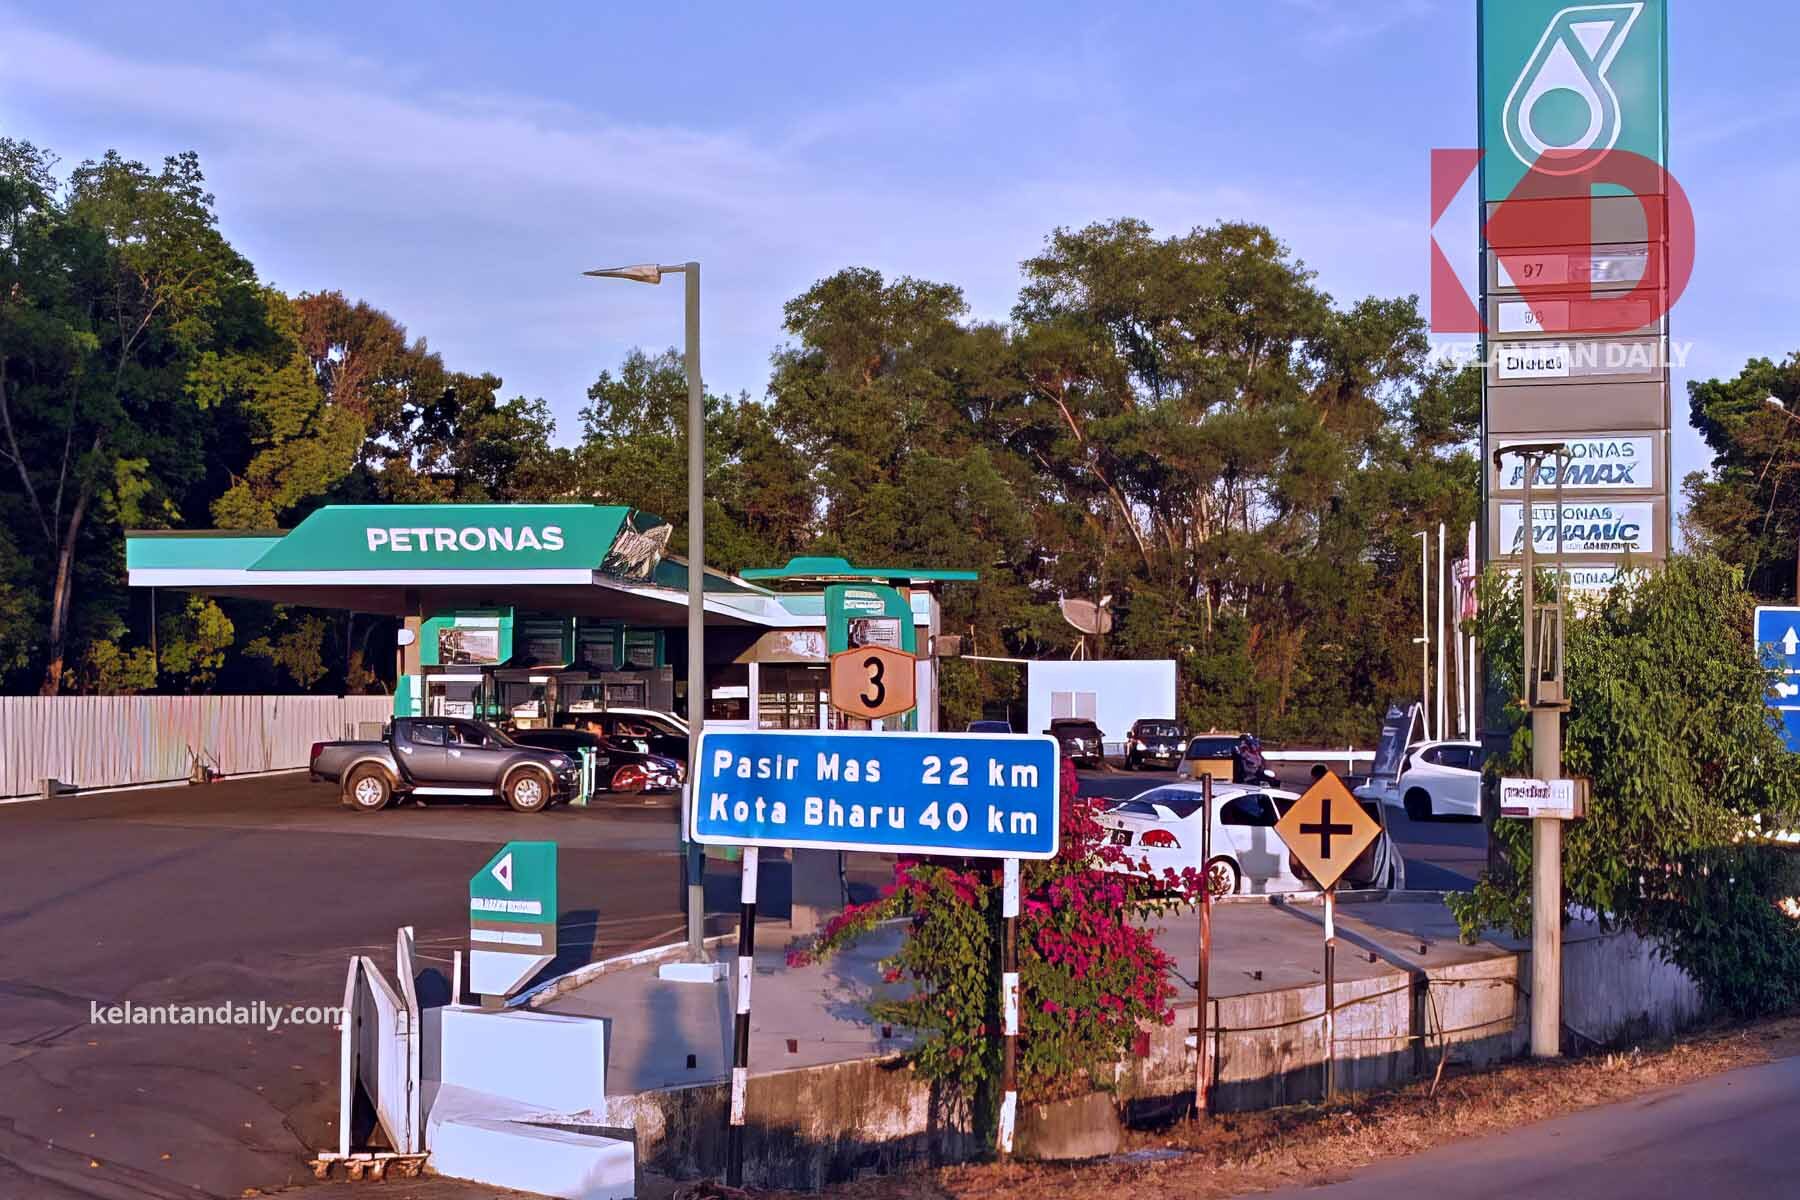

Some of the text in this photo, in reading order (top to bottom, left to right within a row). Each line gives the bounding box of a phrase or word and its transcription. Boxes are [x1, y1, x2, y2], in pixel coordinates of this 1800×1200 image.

[366, 526, 565, 552] PETRONAS
[860, 656, 886, 708] 3
[713, 750, 1038, 788] Pasir Mas 22 km
[709, 793, 1037, 835] Kota Bharu 40 km
